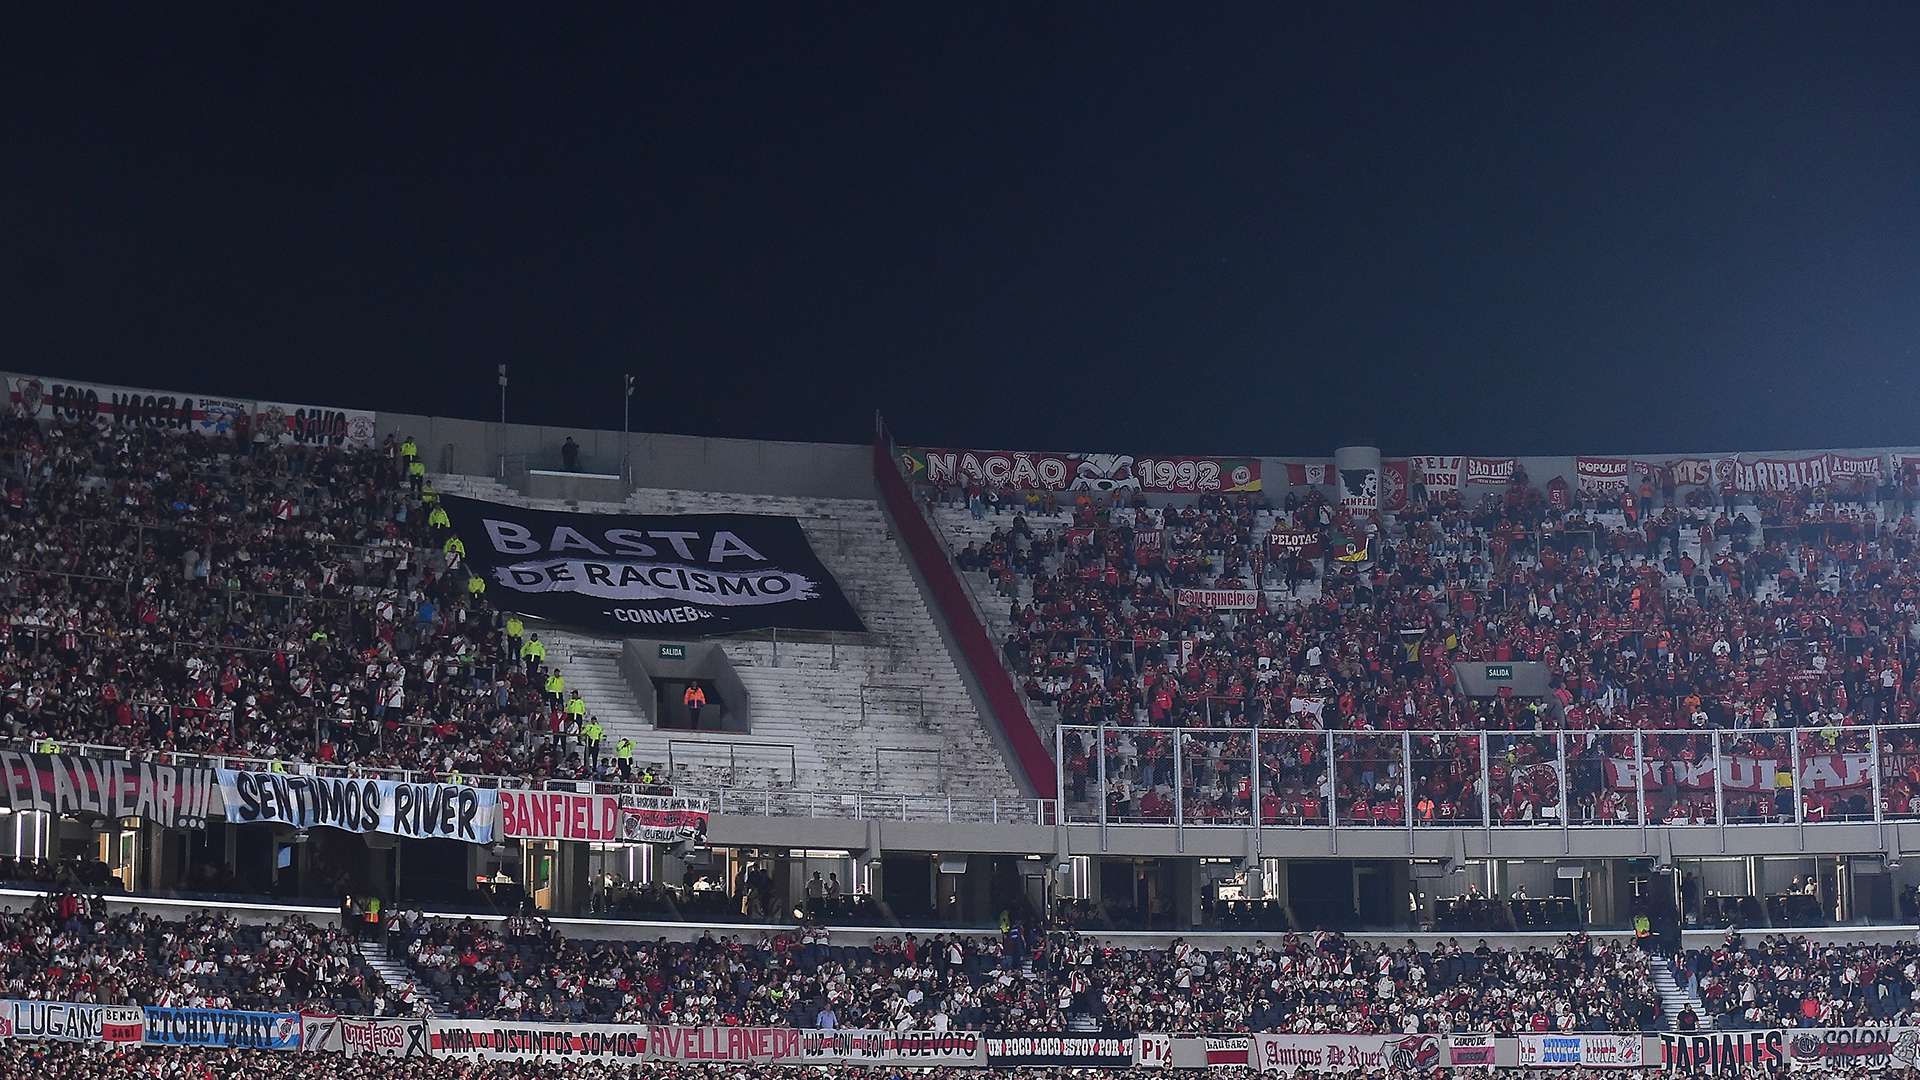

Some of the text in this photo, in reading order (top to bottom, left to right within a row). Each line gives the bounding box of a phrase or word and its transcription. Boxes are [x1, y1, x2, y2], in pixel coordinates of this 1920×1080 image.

[1138, 459, 1221, 492] 1992
[1578, 462, 1627, 474] POPULAR
[483, 518, 768, 562] BASTA
[1271, 532, 1318, 546] PELOTAS
[511, 562, 791, 597] DE RACISMO
[661, 647, 683, 657] SALIDA
[1488, 669, 1510, 677] SALIDA
[2, 752, 50, 811] EL
[237, 771, 479, 841] SENTIMOS RIVER
[503, 792, 619, 842] BANFIELD
[106, 1010, 140, 1021] BENJA
[147, 1009, 274, 1047] ETCHEVERRY
[440, 1028, 476, 1053] MIRA
[493, 1029, 573, 1056] DISTINTOS
[580, 1032, 638, 1058] SOMOS
[651, 1026, 800, 1060] AVELLANEDA
[987, 1038, 1003, 1056] UN
[1005, 1038, 1031, 1056] POCO
[1033, 1038, 1061, 1056] LOCO
[1063, 1038, 1096, 1056] ESTOY
[1098, 1039, 1119, 1056] POR
[1265, 1041, 1383, 1068] Amigos De River
[1660, 1030, 1784, 1077] TAPIALES
